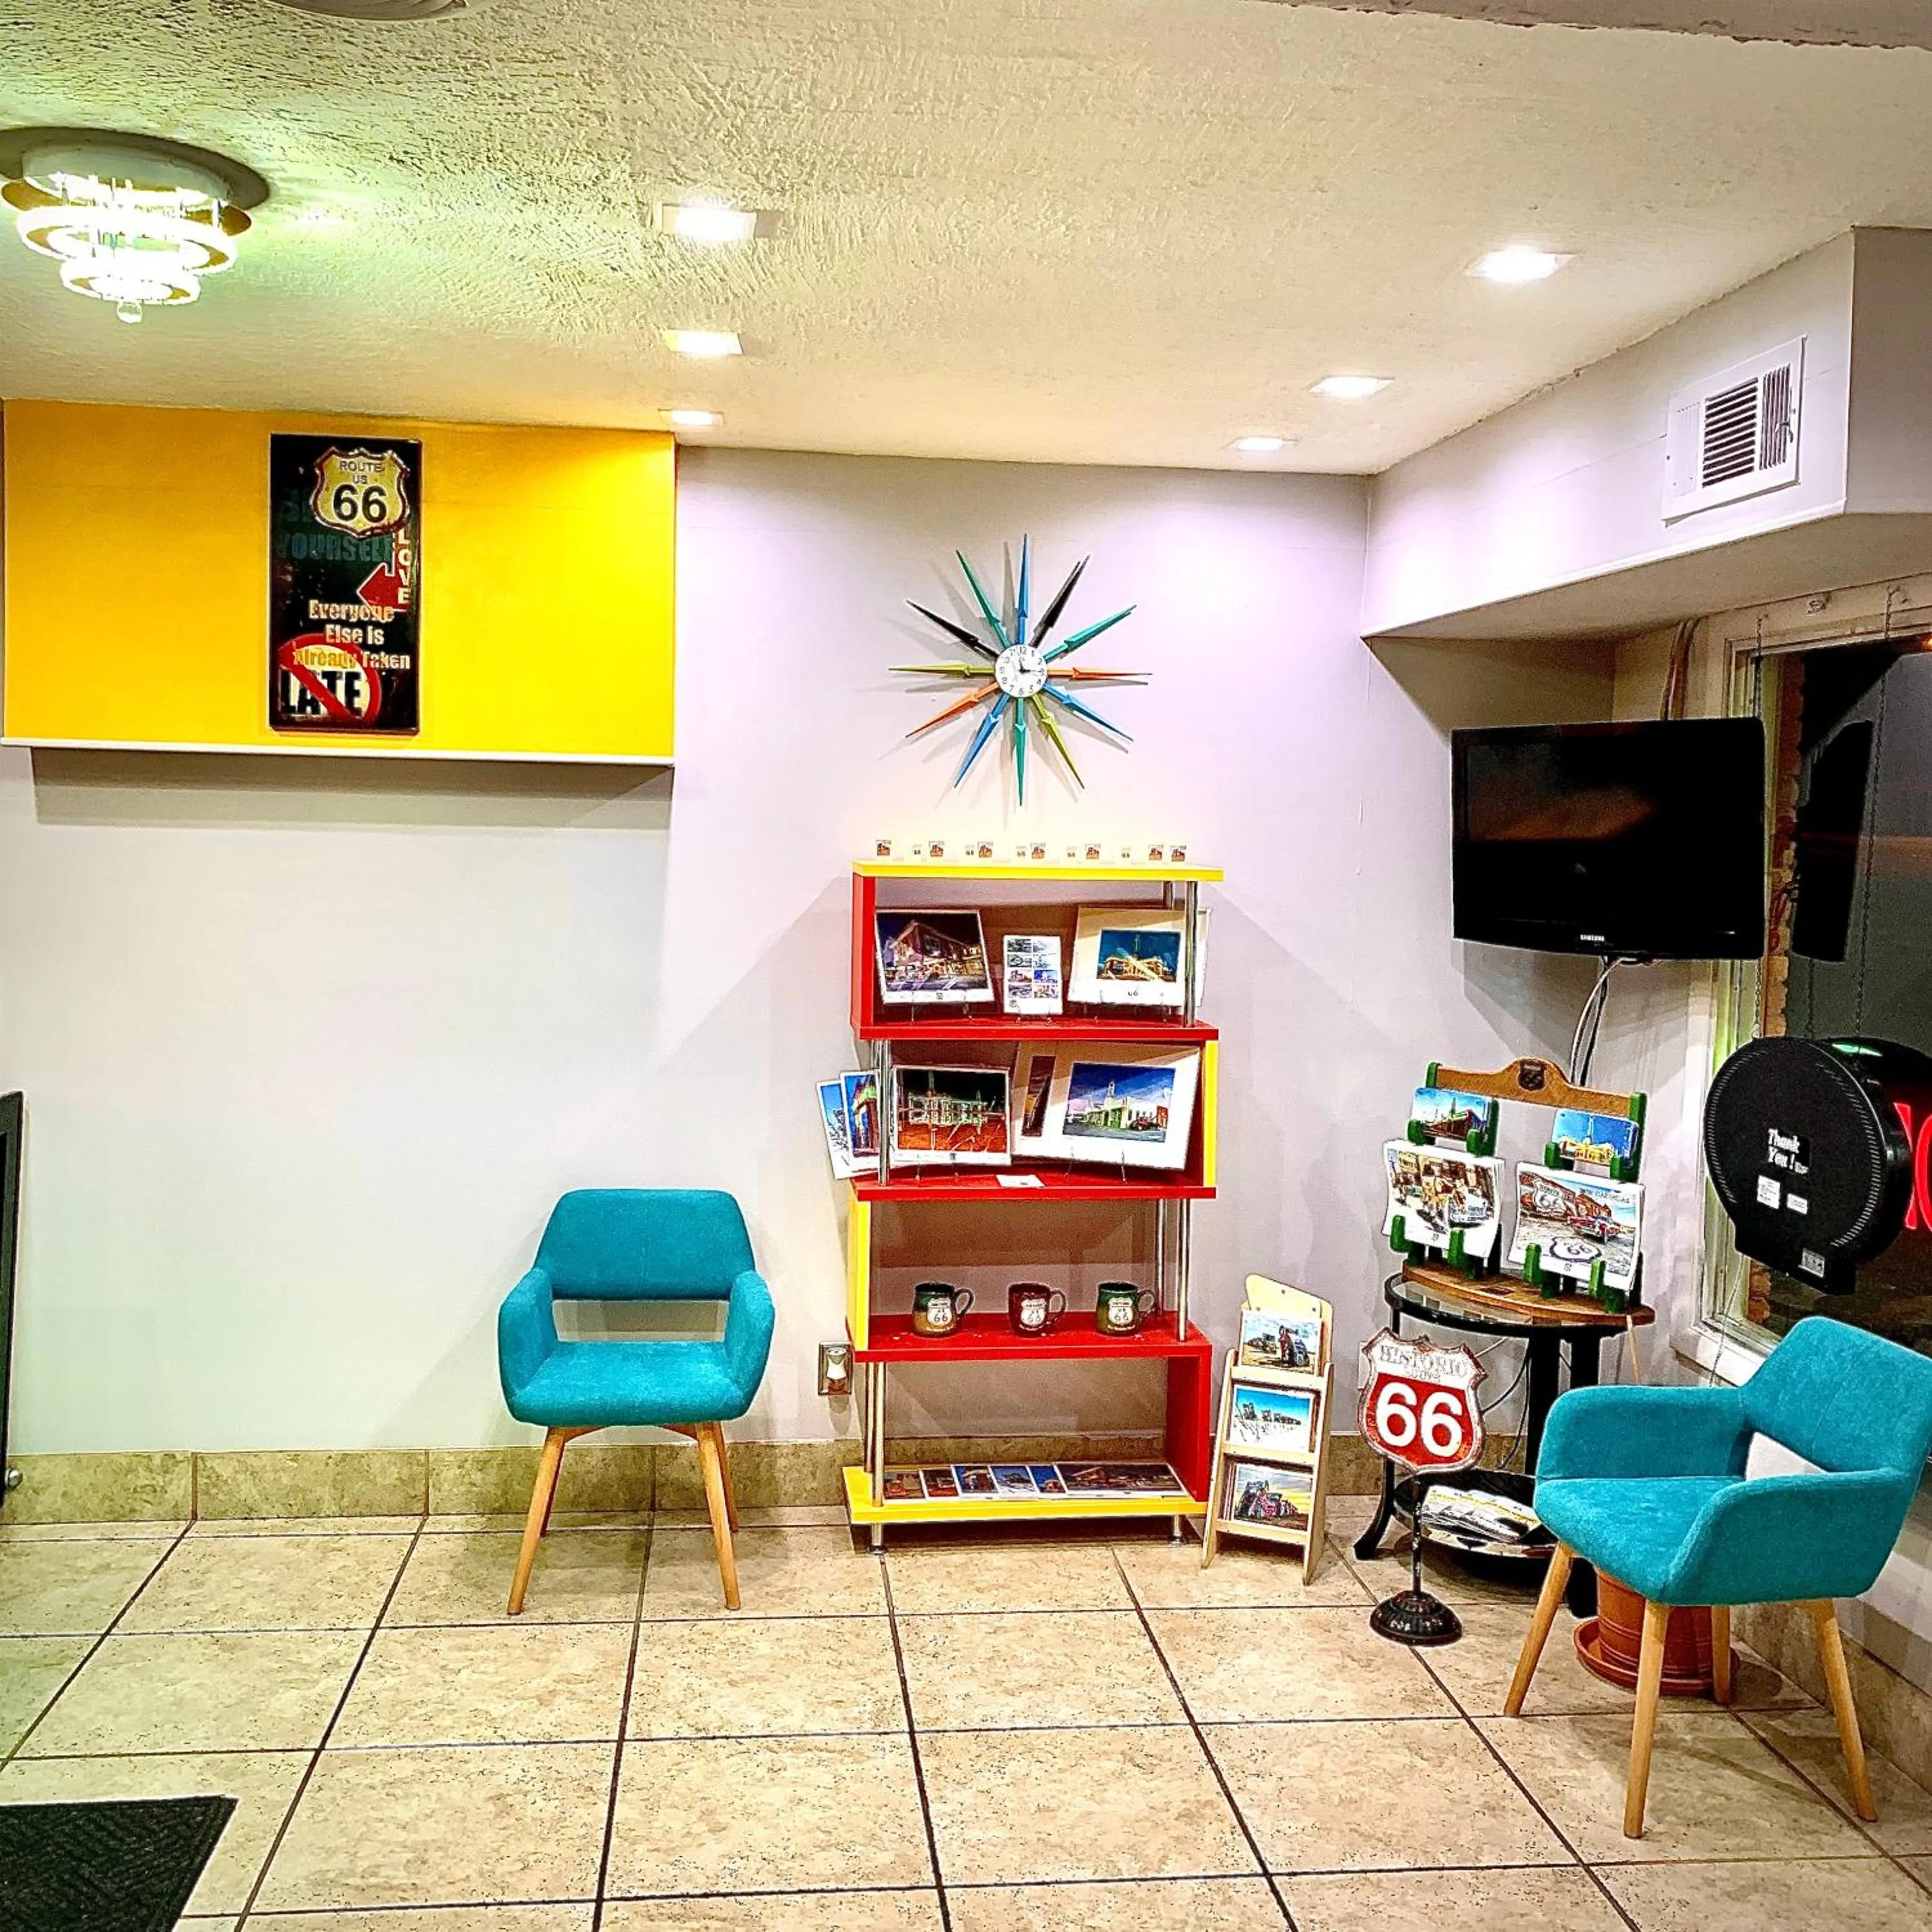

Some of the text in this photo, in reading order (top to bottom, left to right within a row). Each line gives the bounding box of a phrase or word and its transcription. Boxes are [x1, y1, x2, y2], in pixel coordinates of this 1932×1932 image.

[339, 460, 383, 473] ROUTE
[352, 475, 368, 485] US
[332, 484, 387, 524] 66
[397, 528, 412, 605] LOVE
[308, 599, 395, 623] Everyone
[325, 623, 363, 644] Else
[292, 647, 411, 670] Already Taken
[1019, 646, 1027, 654] 12
[280, 670, 363, 717] LATE
[1009, 685, 1014, 693] 7
[1018, 687, 1024, 696] 6
[1768, 1128, 1800, 1153] Thank
[1376, 1381, 1463, 1457] 66
